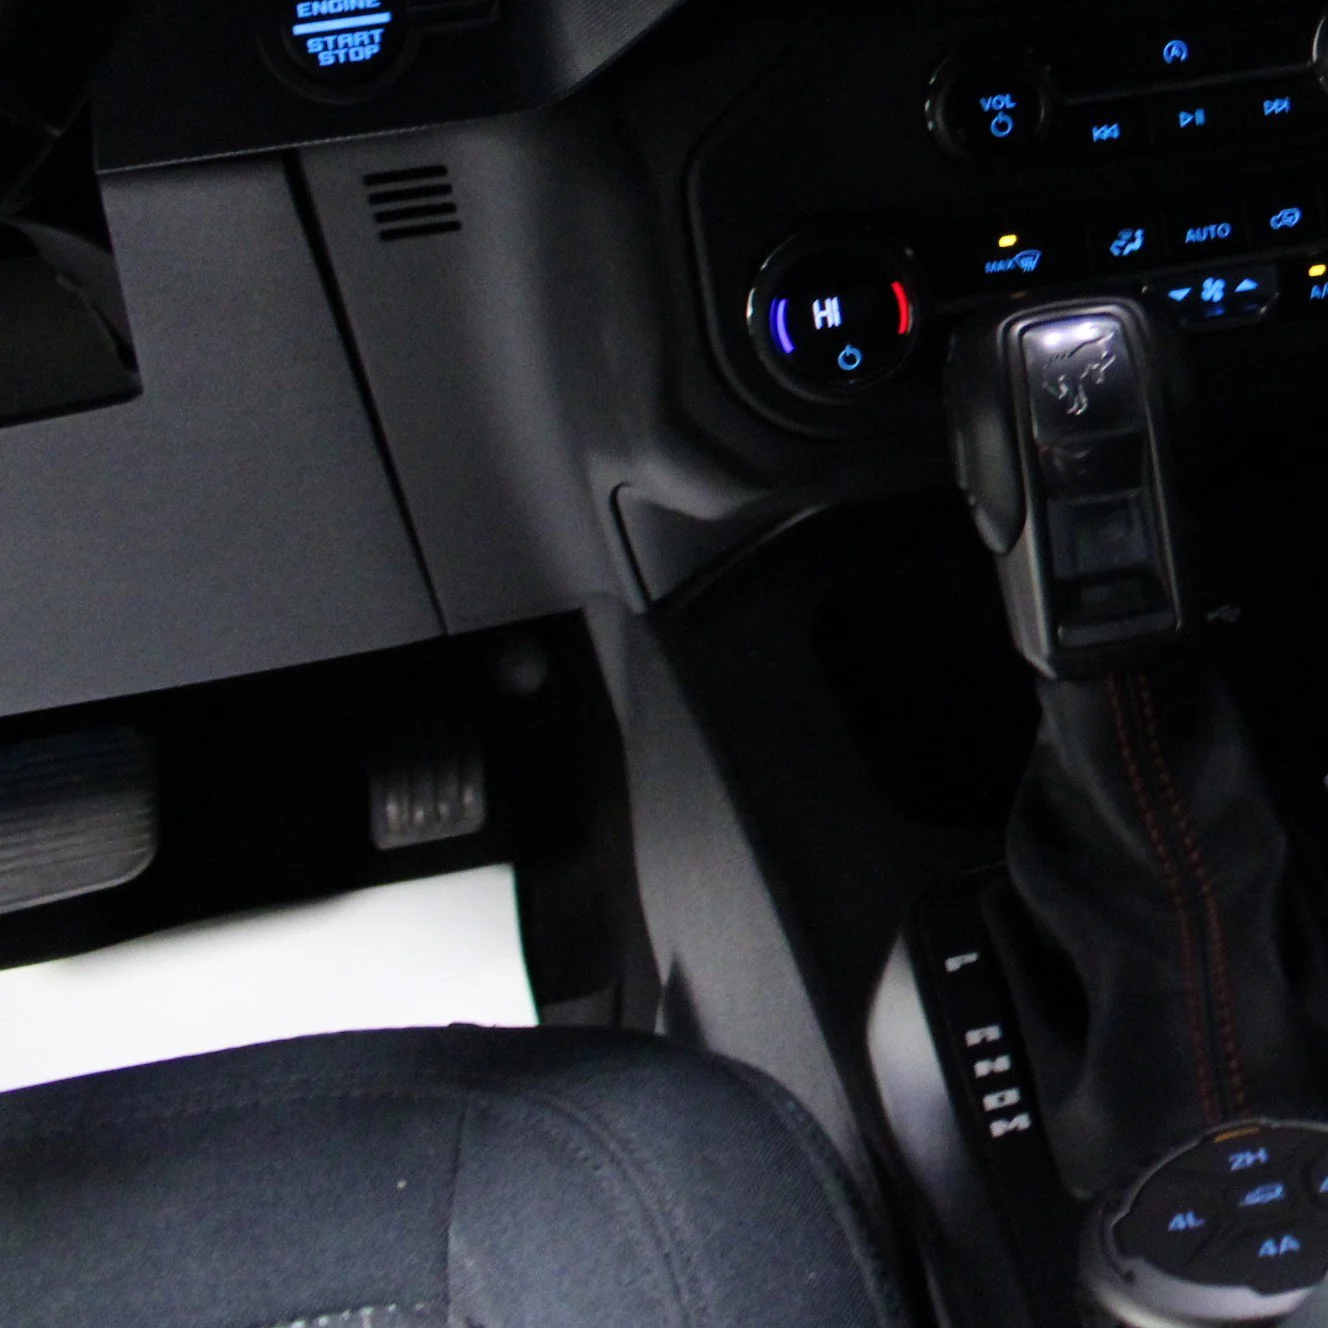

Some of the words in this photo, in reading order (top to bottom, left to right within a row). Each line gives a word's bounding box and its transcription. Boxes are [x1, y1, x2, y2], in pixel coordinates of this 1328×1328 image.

[307, 29, 384, 53] START
[318, 44, 380, 66] STOP
[979, 93, 1017, 112] VOL
[1185, 222, 1232, 244] AUTO
[812, 296, 842, 330] HI
[1228, 1147, 1269, 1171] 2H
[1168, 1210, 1205, 1232] 4L
[1258, 1234, 1301, 1258] 4A
